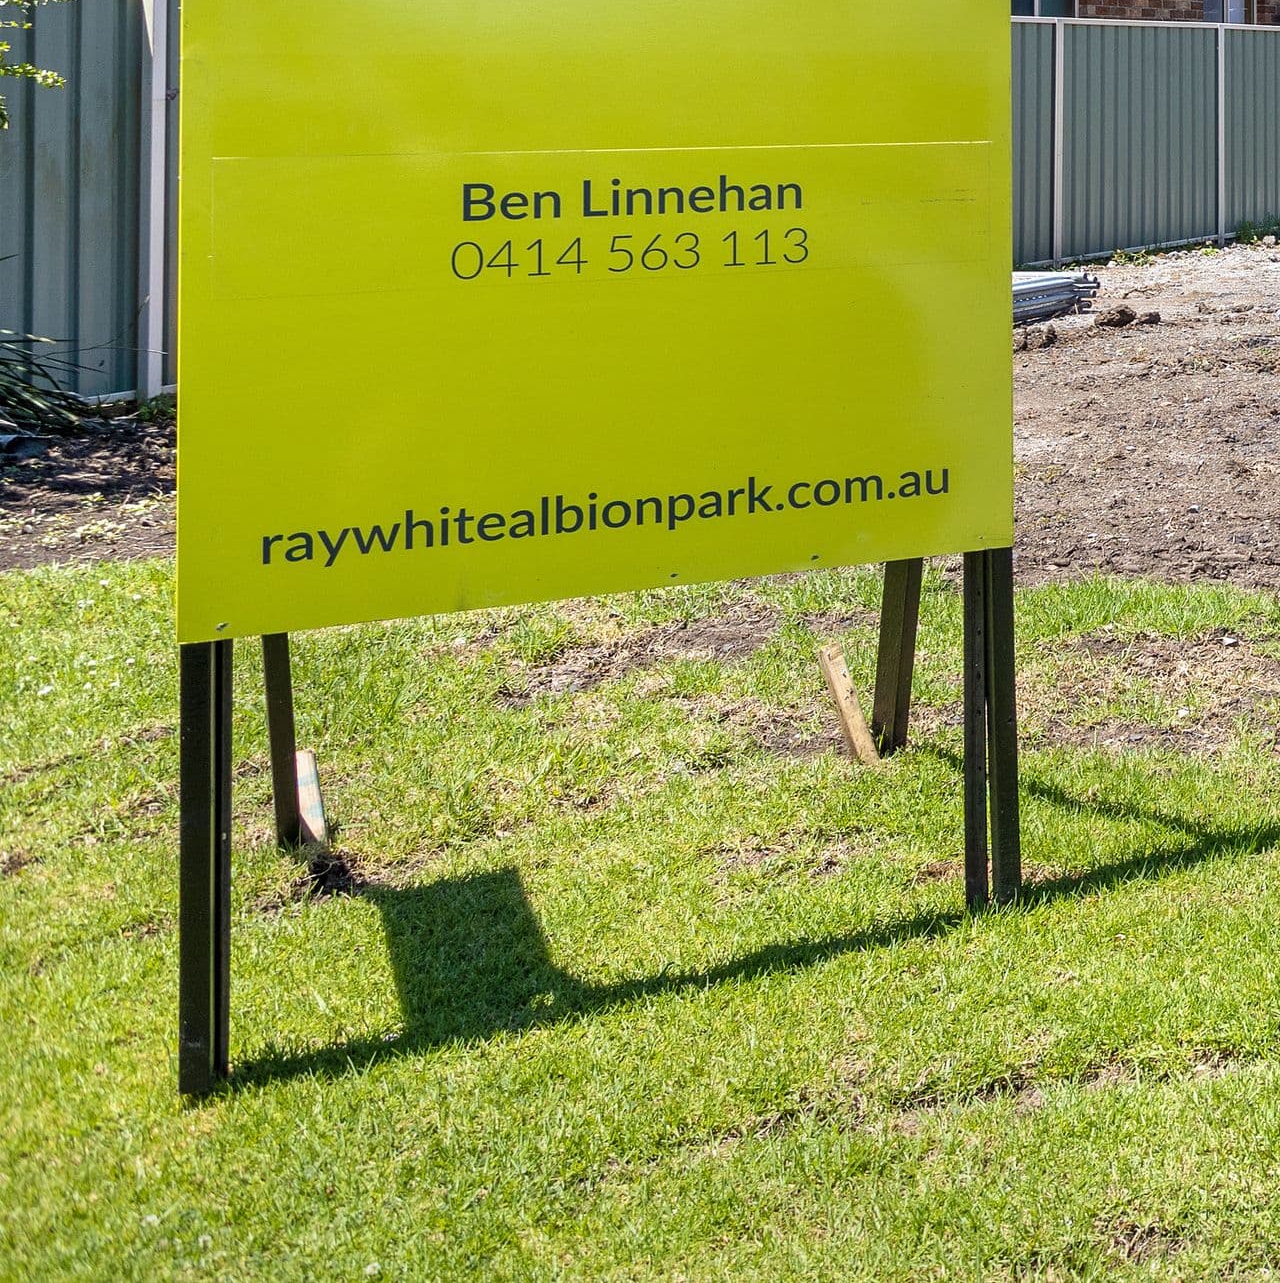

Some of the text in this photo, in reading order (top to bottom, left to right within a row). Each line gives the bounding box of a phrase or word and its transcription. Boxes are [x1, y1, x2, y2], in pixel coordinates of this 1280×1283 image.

[461, 173, 803, 222] Ben Linnehan
[450, 226, 811, 280] 0414 563 113
[262, 468, 950, 568] raywhitealbionpark.com.au
